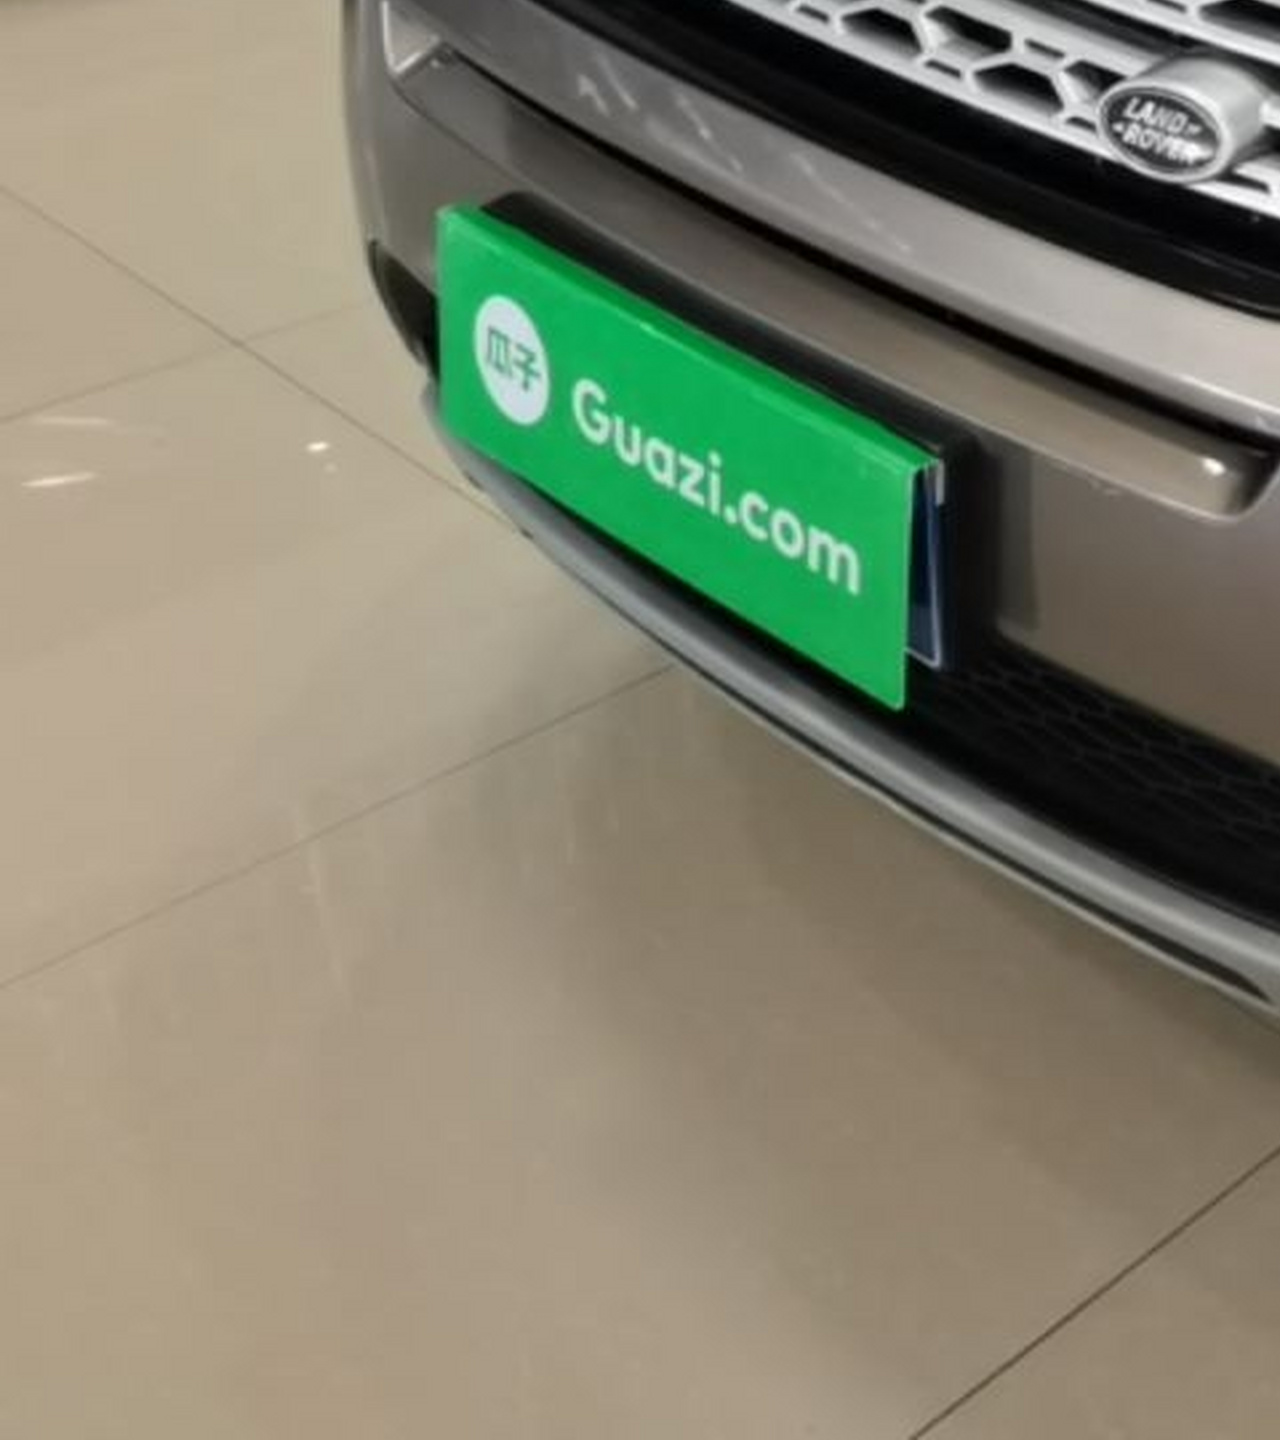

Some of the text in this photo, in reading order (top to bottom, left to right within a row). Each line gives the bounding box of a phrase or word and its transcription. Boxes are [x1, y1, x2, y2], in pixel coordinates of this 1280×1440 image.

[1122, 97, 1189, 135] LAND
[1122, 122, 1203, 164] ROVER
[484, 325, 541, 392] 瓜子
[572, 378, 863, 596] Guazi.com
